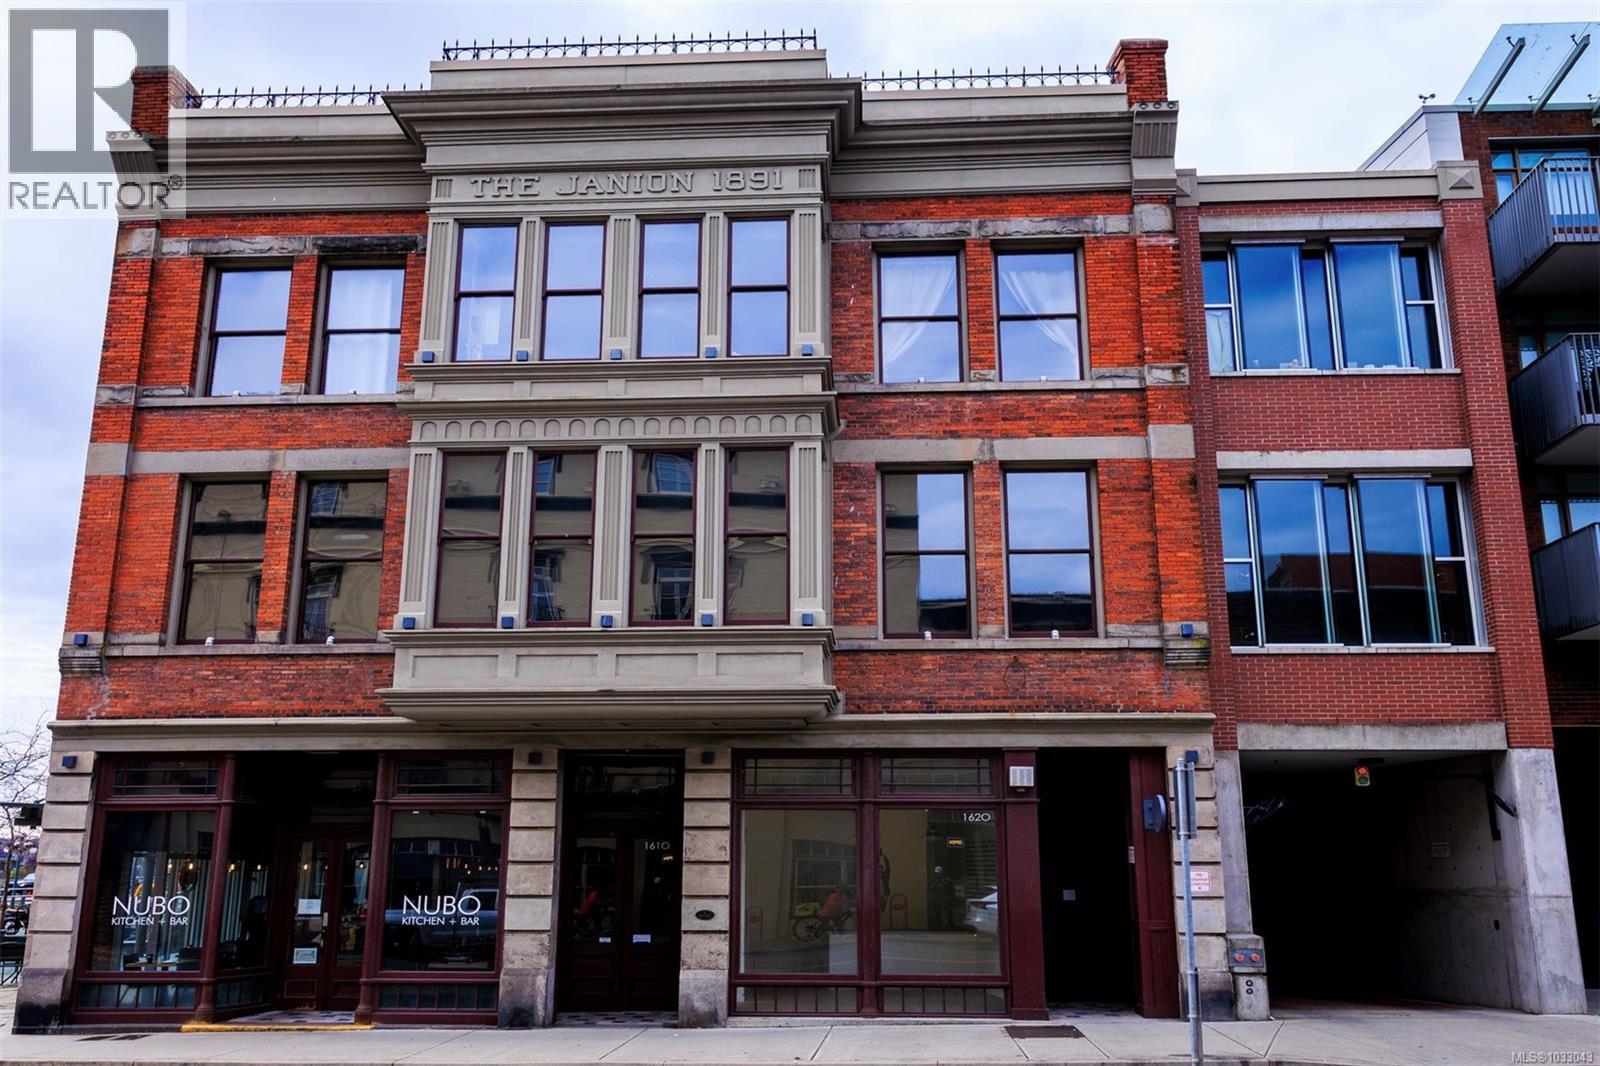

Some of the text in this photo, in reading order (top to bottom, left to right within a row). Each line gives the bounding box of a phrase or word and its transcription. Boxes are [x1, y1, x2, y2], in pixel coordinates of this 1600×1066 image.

[470, 168, 784, 198] THE JANION 1891
[963, 812, 991, 822] 1620
[645, 841, 671, 850] 1610
[112, 895, 191, 916] NUBO
[402, 895, 481, 916] NUBO
[111, 916, 155, 926] KITCHEN
[169, 916, 189, 926] BAR
[401, 916, 446, 926] KITCHEN
[460, 916, 480, 926] BAR
